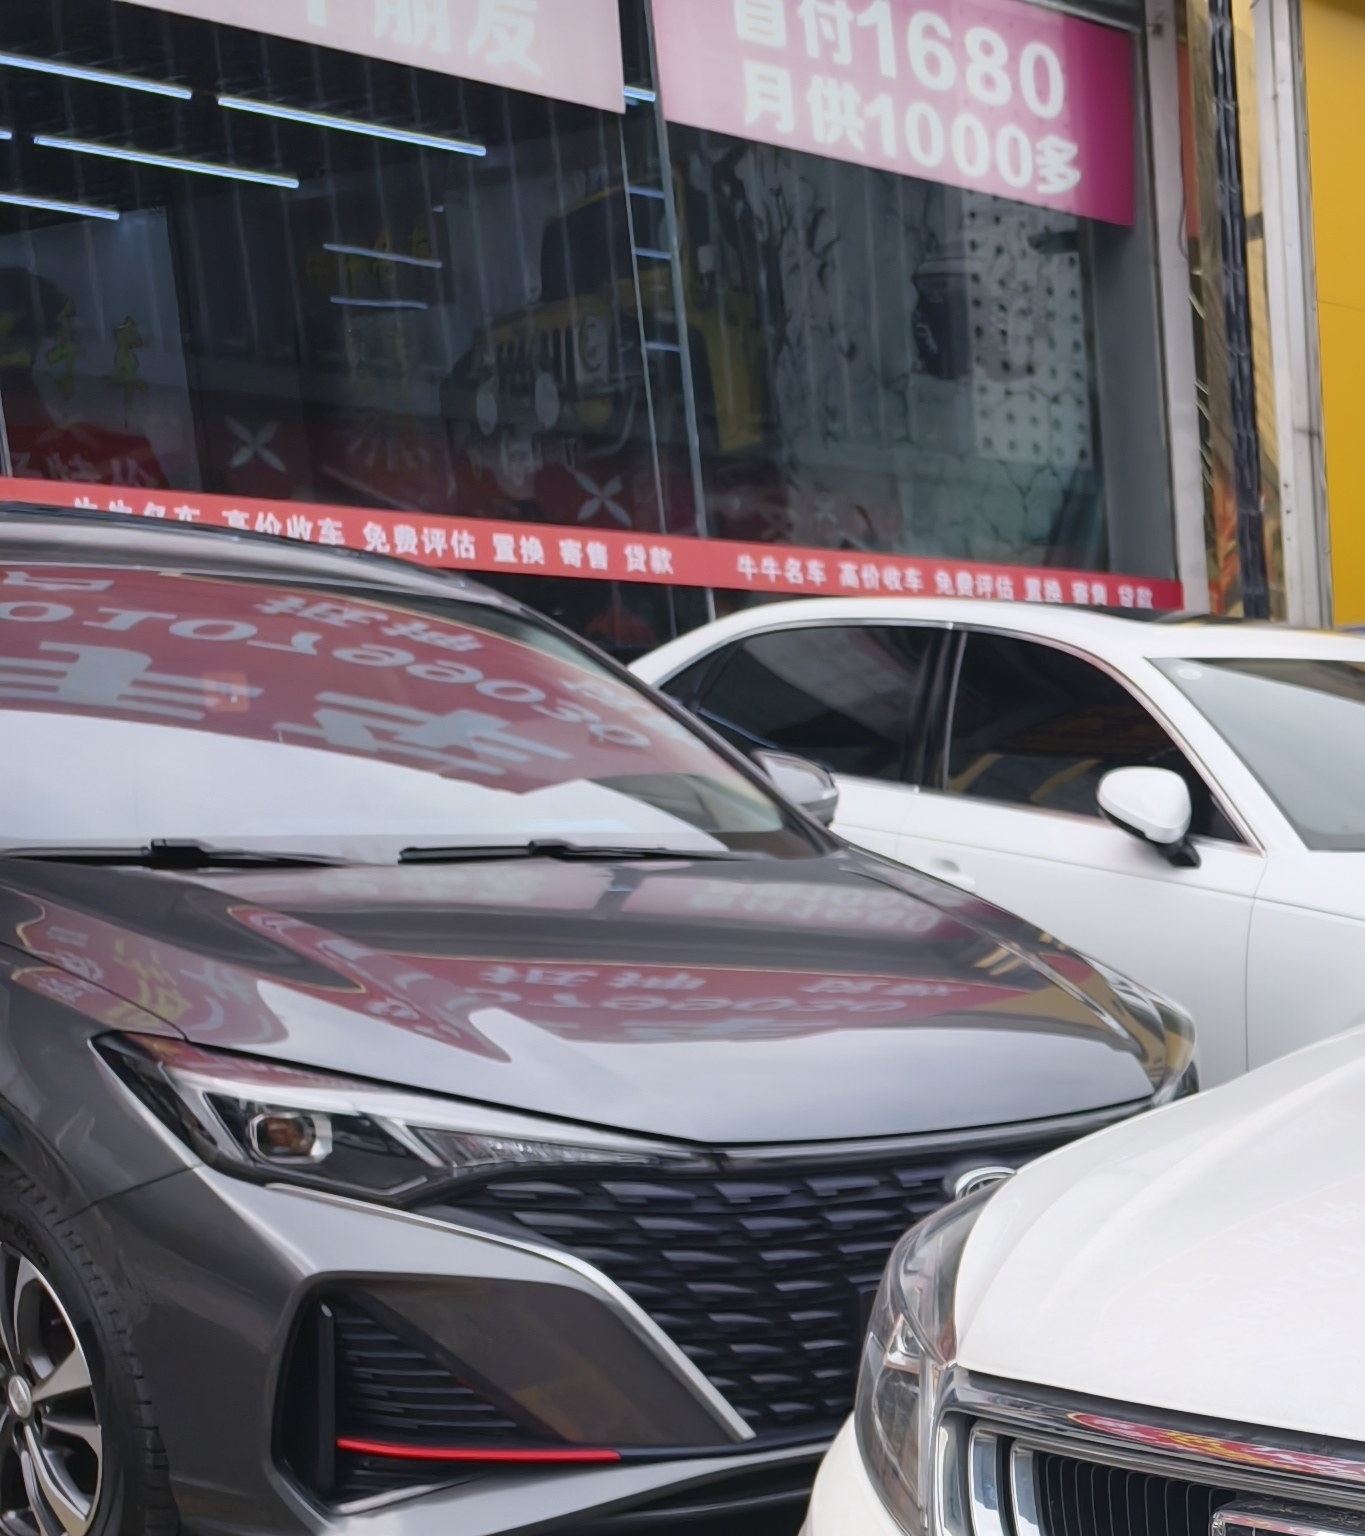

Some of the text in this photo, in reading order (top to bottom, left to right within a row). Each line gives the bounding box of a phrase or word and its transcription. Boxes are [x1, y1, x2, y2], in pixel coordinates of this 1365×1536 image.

[308, 0, 543, 76] 朋友
[743, 59, 1081, 194] 月供1000多
[363, 521, 475, 560] 免费评估
[493, 532, 545, 566] 置换
[624, 544, 674, 575] 贷款
[737, 554, 827, 585] 牛牛名车
[839, 563, 923, 593] 高价收车
